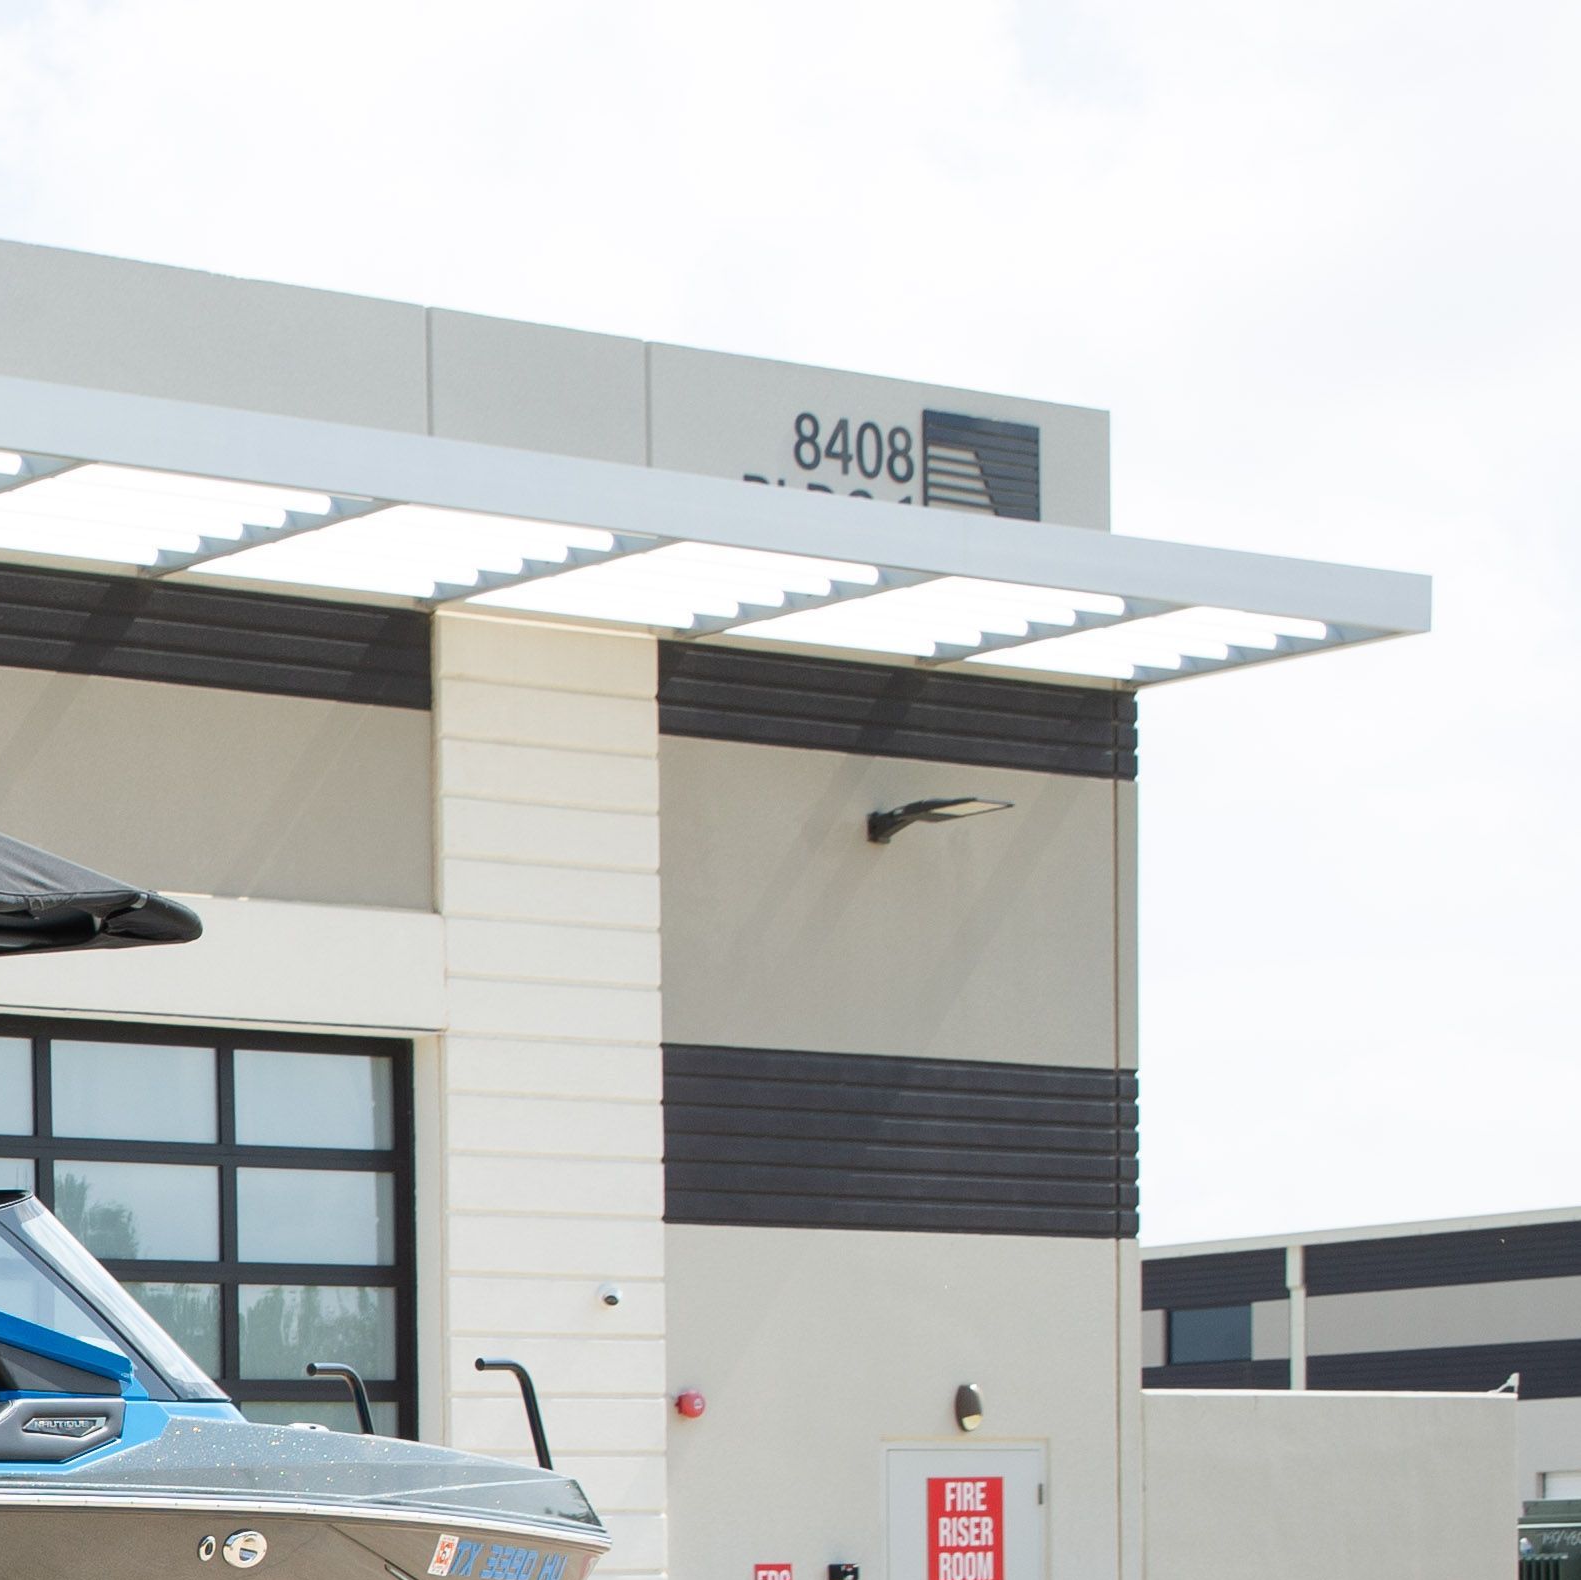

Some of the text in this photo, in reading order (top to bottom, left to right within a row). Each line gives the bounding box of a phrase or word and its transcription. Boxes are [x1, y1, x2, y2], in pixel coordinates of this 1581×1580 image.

[793, 412, 915, 484] 8408
[944, 1481, 987, 1511] FIRE
[938, 1517, 994, 1547] RISER
[450, 1540, 485, 1577] TX
